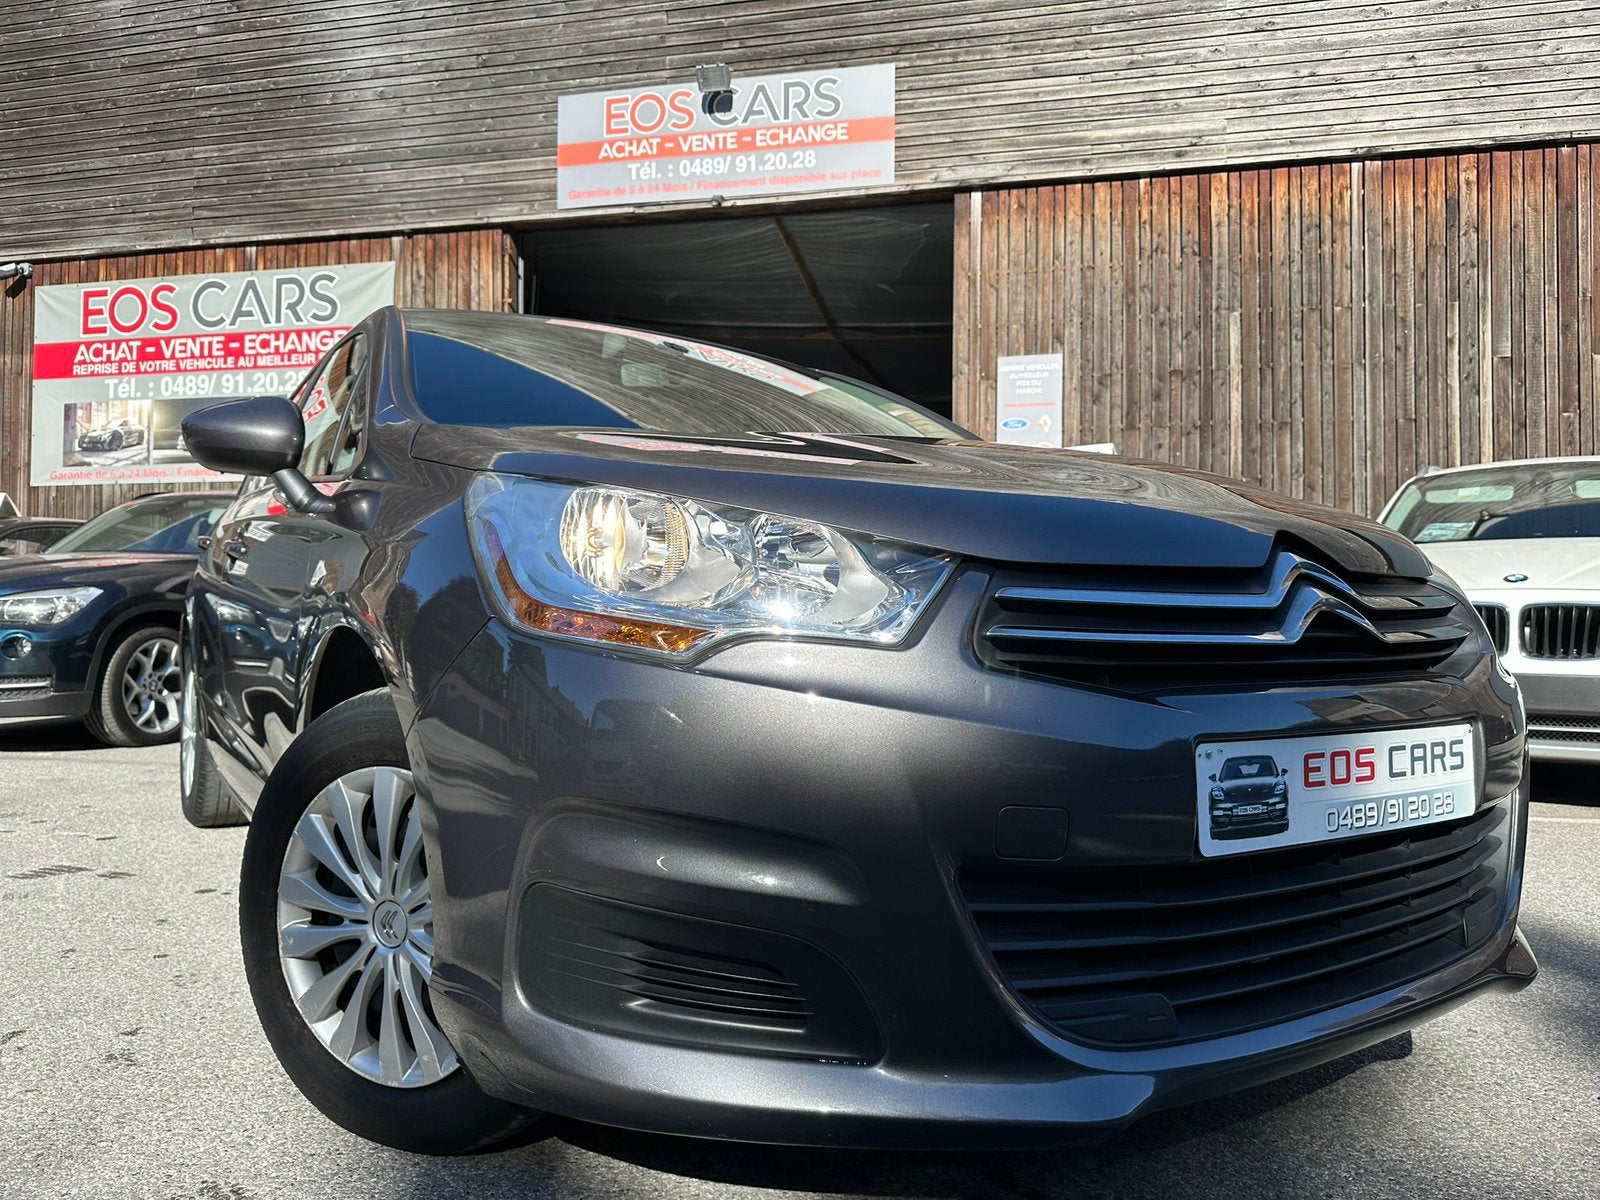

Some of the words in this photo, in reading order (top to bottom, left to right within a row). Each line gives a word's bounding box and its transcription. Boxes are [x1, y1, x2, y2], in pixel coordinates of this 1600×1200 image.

[604, 91, 695, 136] EOS
[598, 138, 661, 159] ACHAT
[678, 132, 738, 151] VENTE
[755, 123, 849, 147] ECHANGE
[627, 161, 662, 181] Tél.
[668, 164, 674, 178] :
[679, 156, 731, 177] 0489/
[735, 150, 817, 174] 91.20.28
[568, 187, 611, 200] Garantie
[614, 185, 626, 196] de
[663, 181, 688, 192] Mois
[697, 176, 766, 189] Financement
[769, 173, 826, 187] disponible
[830, 171, 848, 181] sur
[851, 168, 881, 181] place
[82, 284, 178, 335] EOS
[192, 273, 338, 328] CARS
[73, 341, 141, 363] ACHAT
[160, 336, 225, 358] VENTE
[73, 362, 118, 376] REPRISE
[121, 361, 137, 373] DE
[139, 359, 176, 372] VOTRE
[179, 357, 234, 370] VEHICULE
[237, 355, 254, 367] AU
[257, 352, 317, 366] MEILLEUR
[105, 377, 141, 399] Tél.
[148, 382, 154, 397] :
[160, 373, 217, 397] 0489/
[50, 469, 92, 481] Garantie
[96, 468, 107, 479] de
[129, 468, 140, 478] 24
[143, 467, 168, 478] Mois
[1303, 747, 1376, 788] EOS
[1387, 738, 1465, 779] CARS
[1408, 794, 1430, 820] 20
